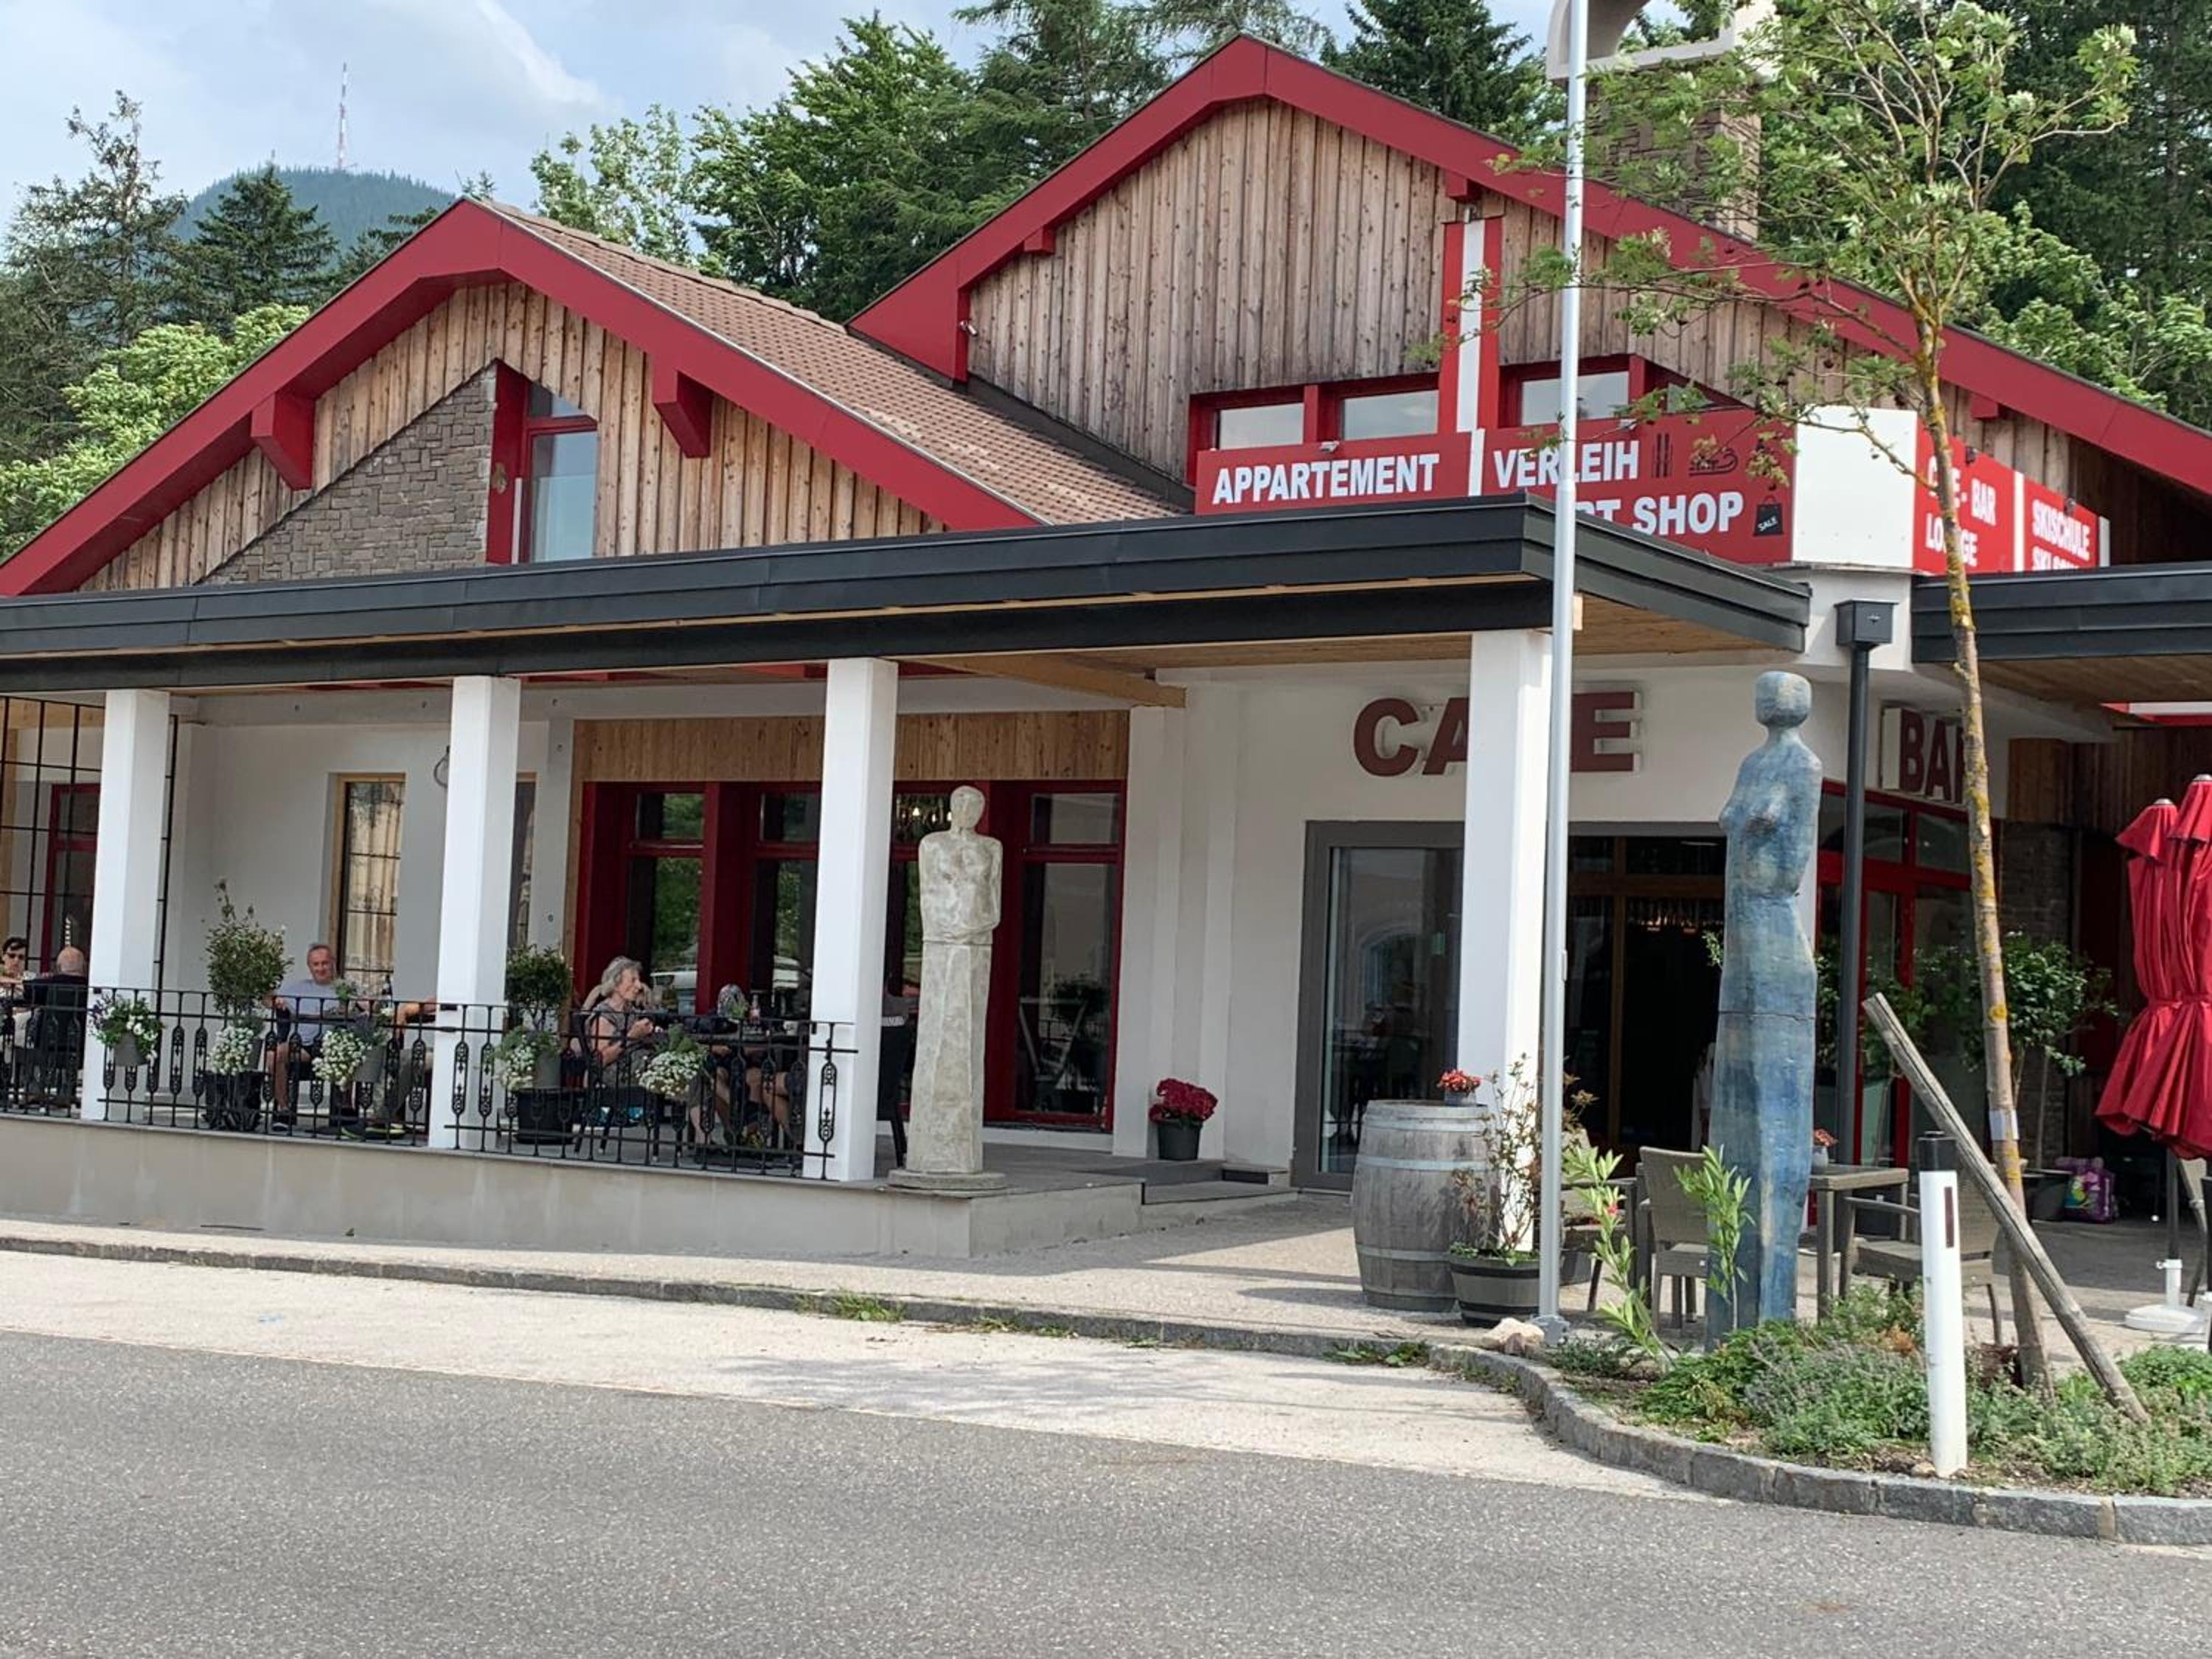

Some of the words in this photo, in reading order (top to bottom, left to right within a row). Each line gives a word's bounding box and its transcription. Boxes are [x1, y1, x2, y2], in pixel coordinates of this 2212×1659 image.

[1212, 453, 1440, 504] APPARTEMENT
[1493, 440, 1639, 488] VEREIH
[1632, 491, 1744, 536] SHOP
[1757, 515, 1778, 532] SALE
[1971, 478, 1997, 526] BAR
[1925, 512, 1978, 567] LOGE
[2032, 499, 2090, 562] SKISCHULE
[1353, 691, 1635, 776] CAE
